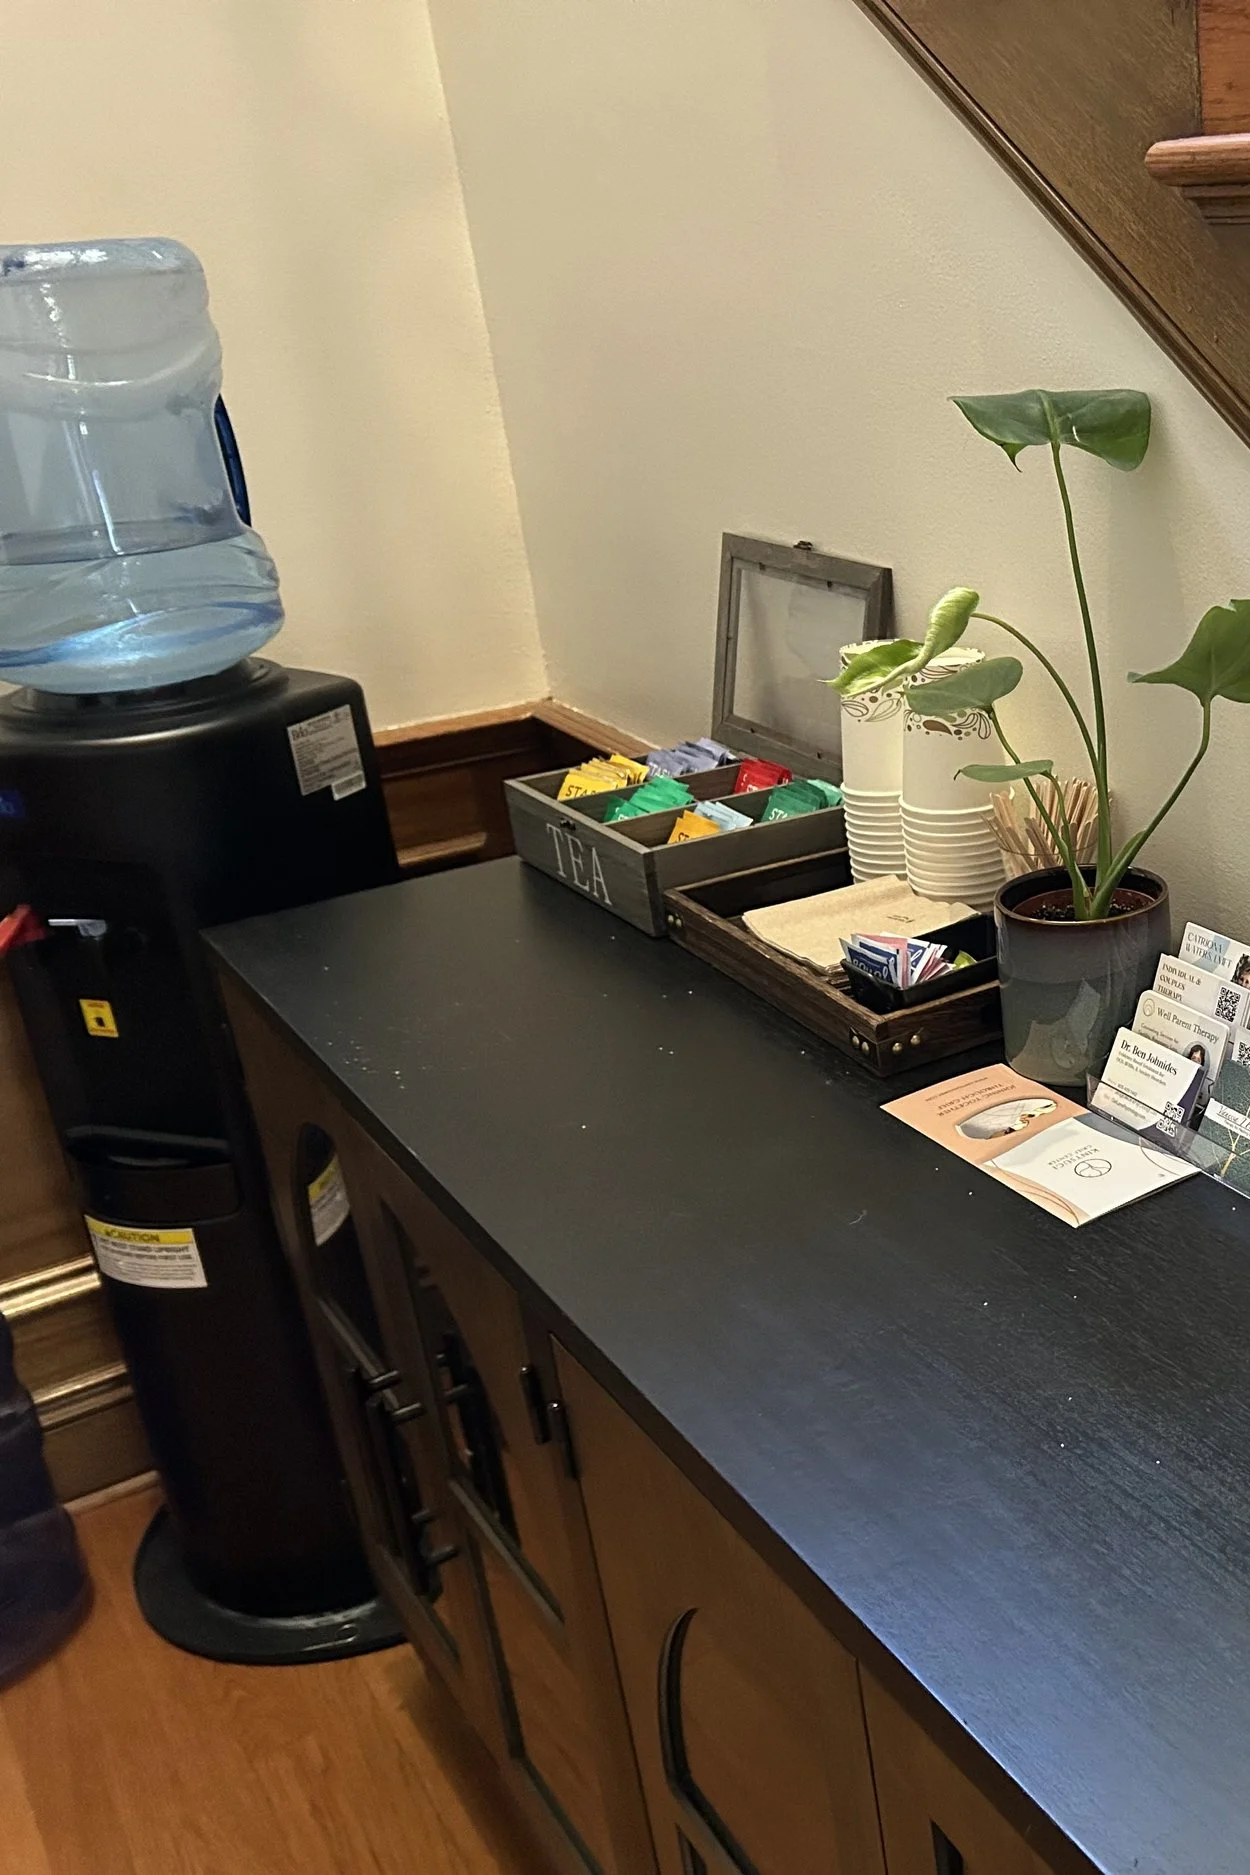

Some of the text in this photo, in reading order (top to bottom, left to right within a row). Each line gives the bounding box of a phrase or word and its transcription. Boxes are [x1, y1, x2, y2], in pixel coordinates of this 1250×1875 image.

[546, 822, 612, 906] TEA
[1187, 932, 1222, 953] CATRIONA
[1159, 974, 1185, 990] COUPLES
[1162, 963, 1201, 986] INDIVIDUAL &
[1157, 984, 1182, 1001] THERAPY
[1156, 1007, 1171, 1021] Well
[1172, 1014, 1193, 1031] Parent
[1193, 1023, 1219, 1045] Therapy
[1120, 1039, 1131, 1052] Dr.
[1132, 1045, 1146, 1060] Ben
